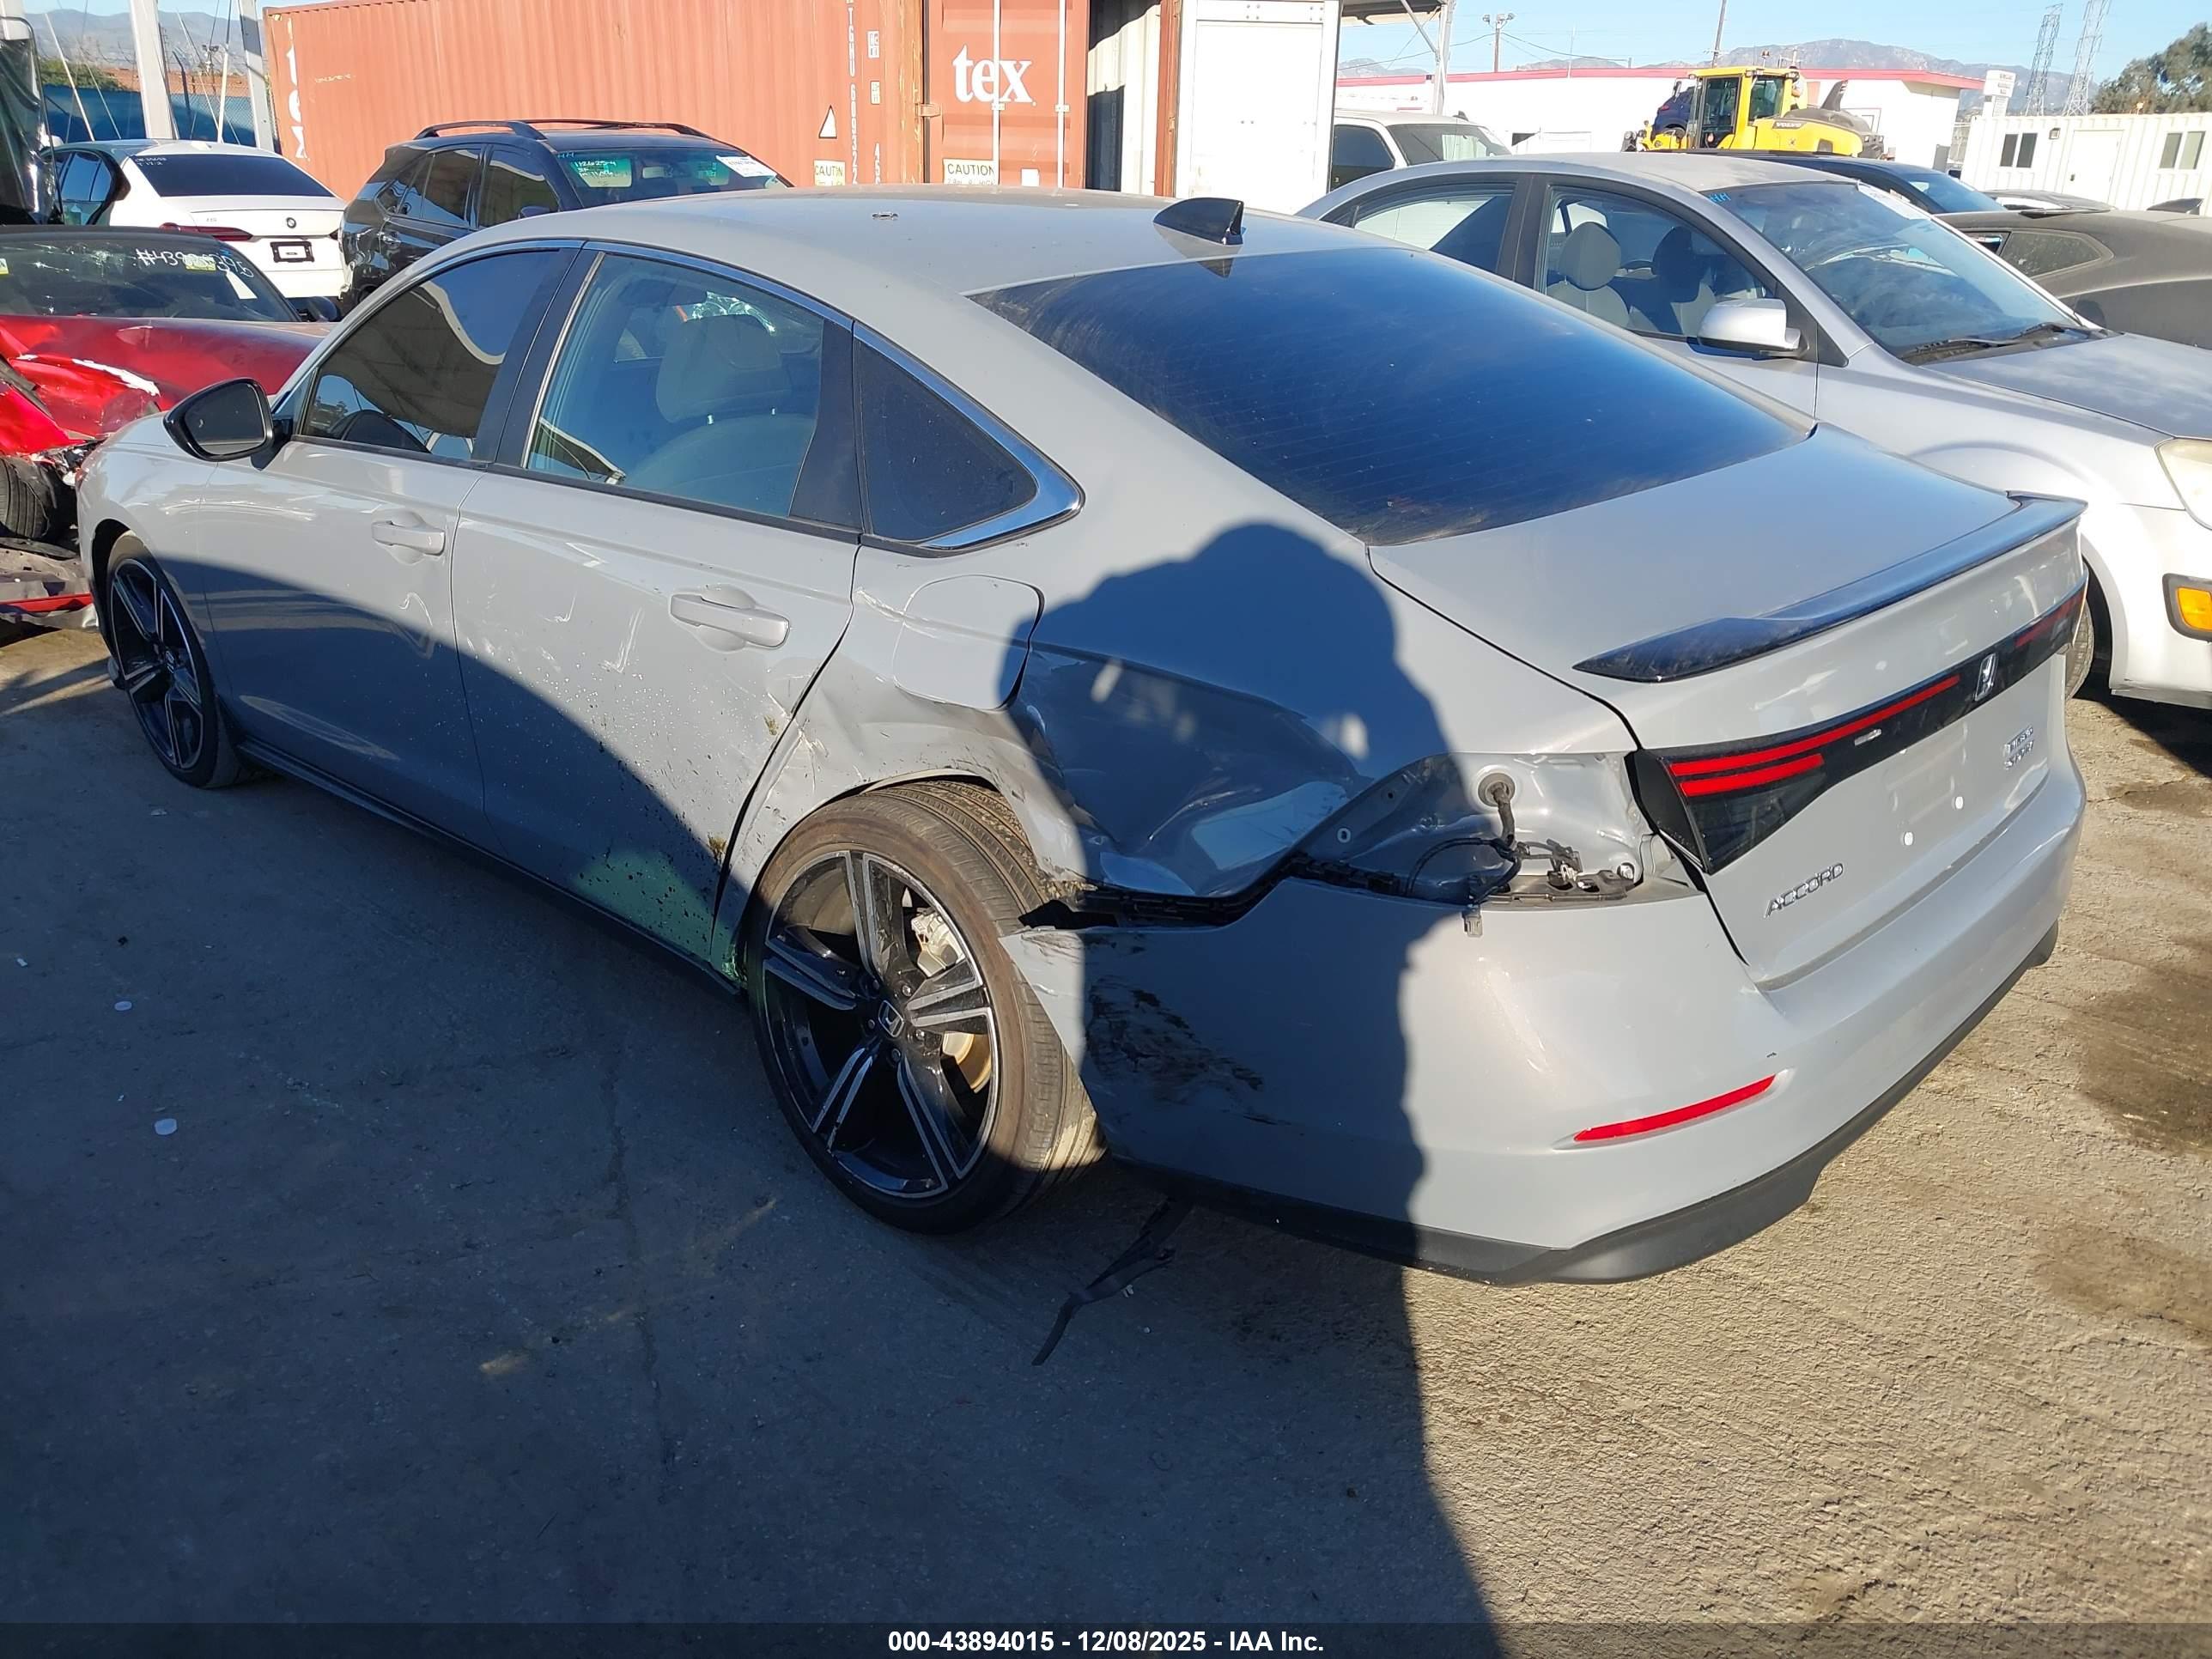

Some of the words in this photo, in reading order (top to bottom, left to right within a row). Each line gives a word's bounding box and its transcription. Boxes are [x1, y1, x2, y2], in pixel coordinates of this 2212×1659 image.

[952, 45, 1033, 103] tex
[947, 163, 995, 176] CAUTION
[1764, 862, 1844, 919] ACCORD
